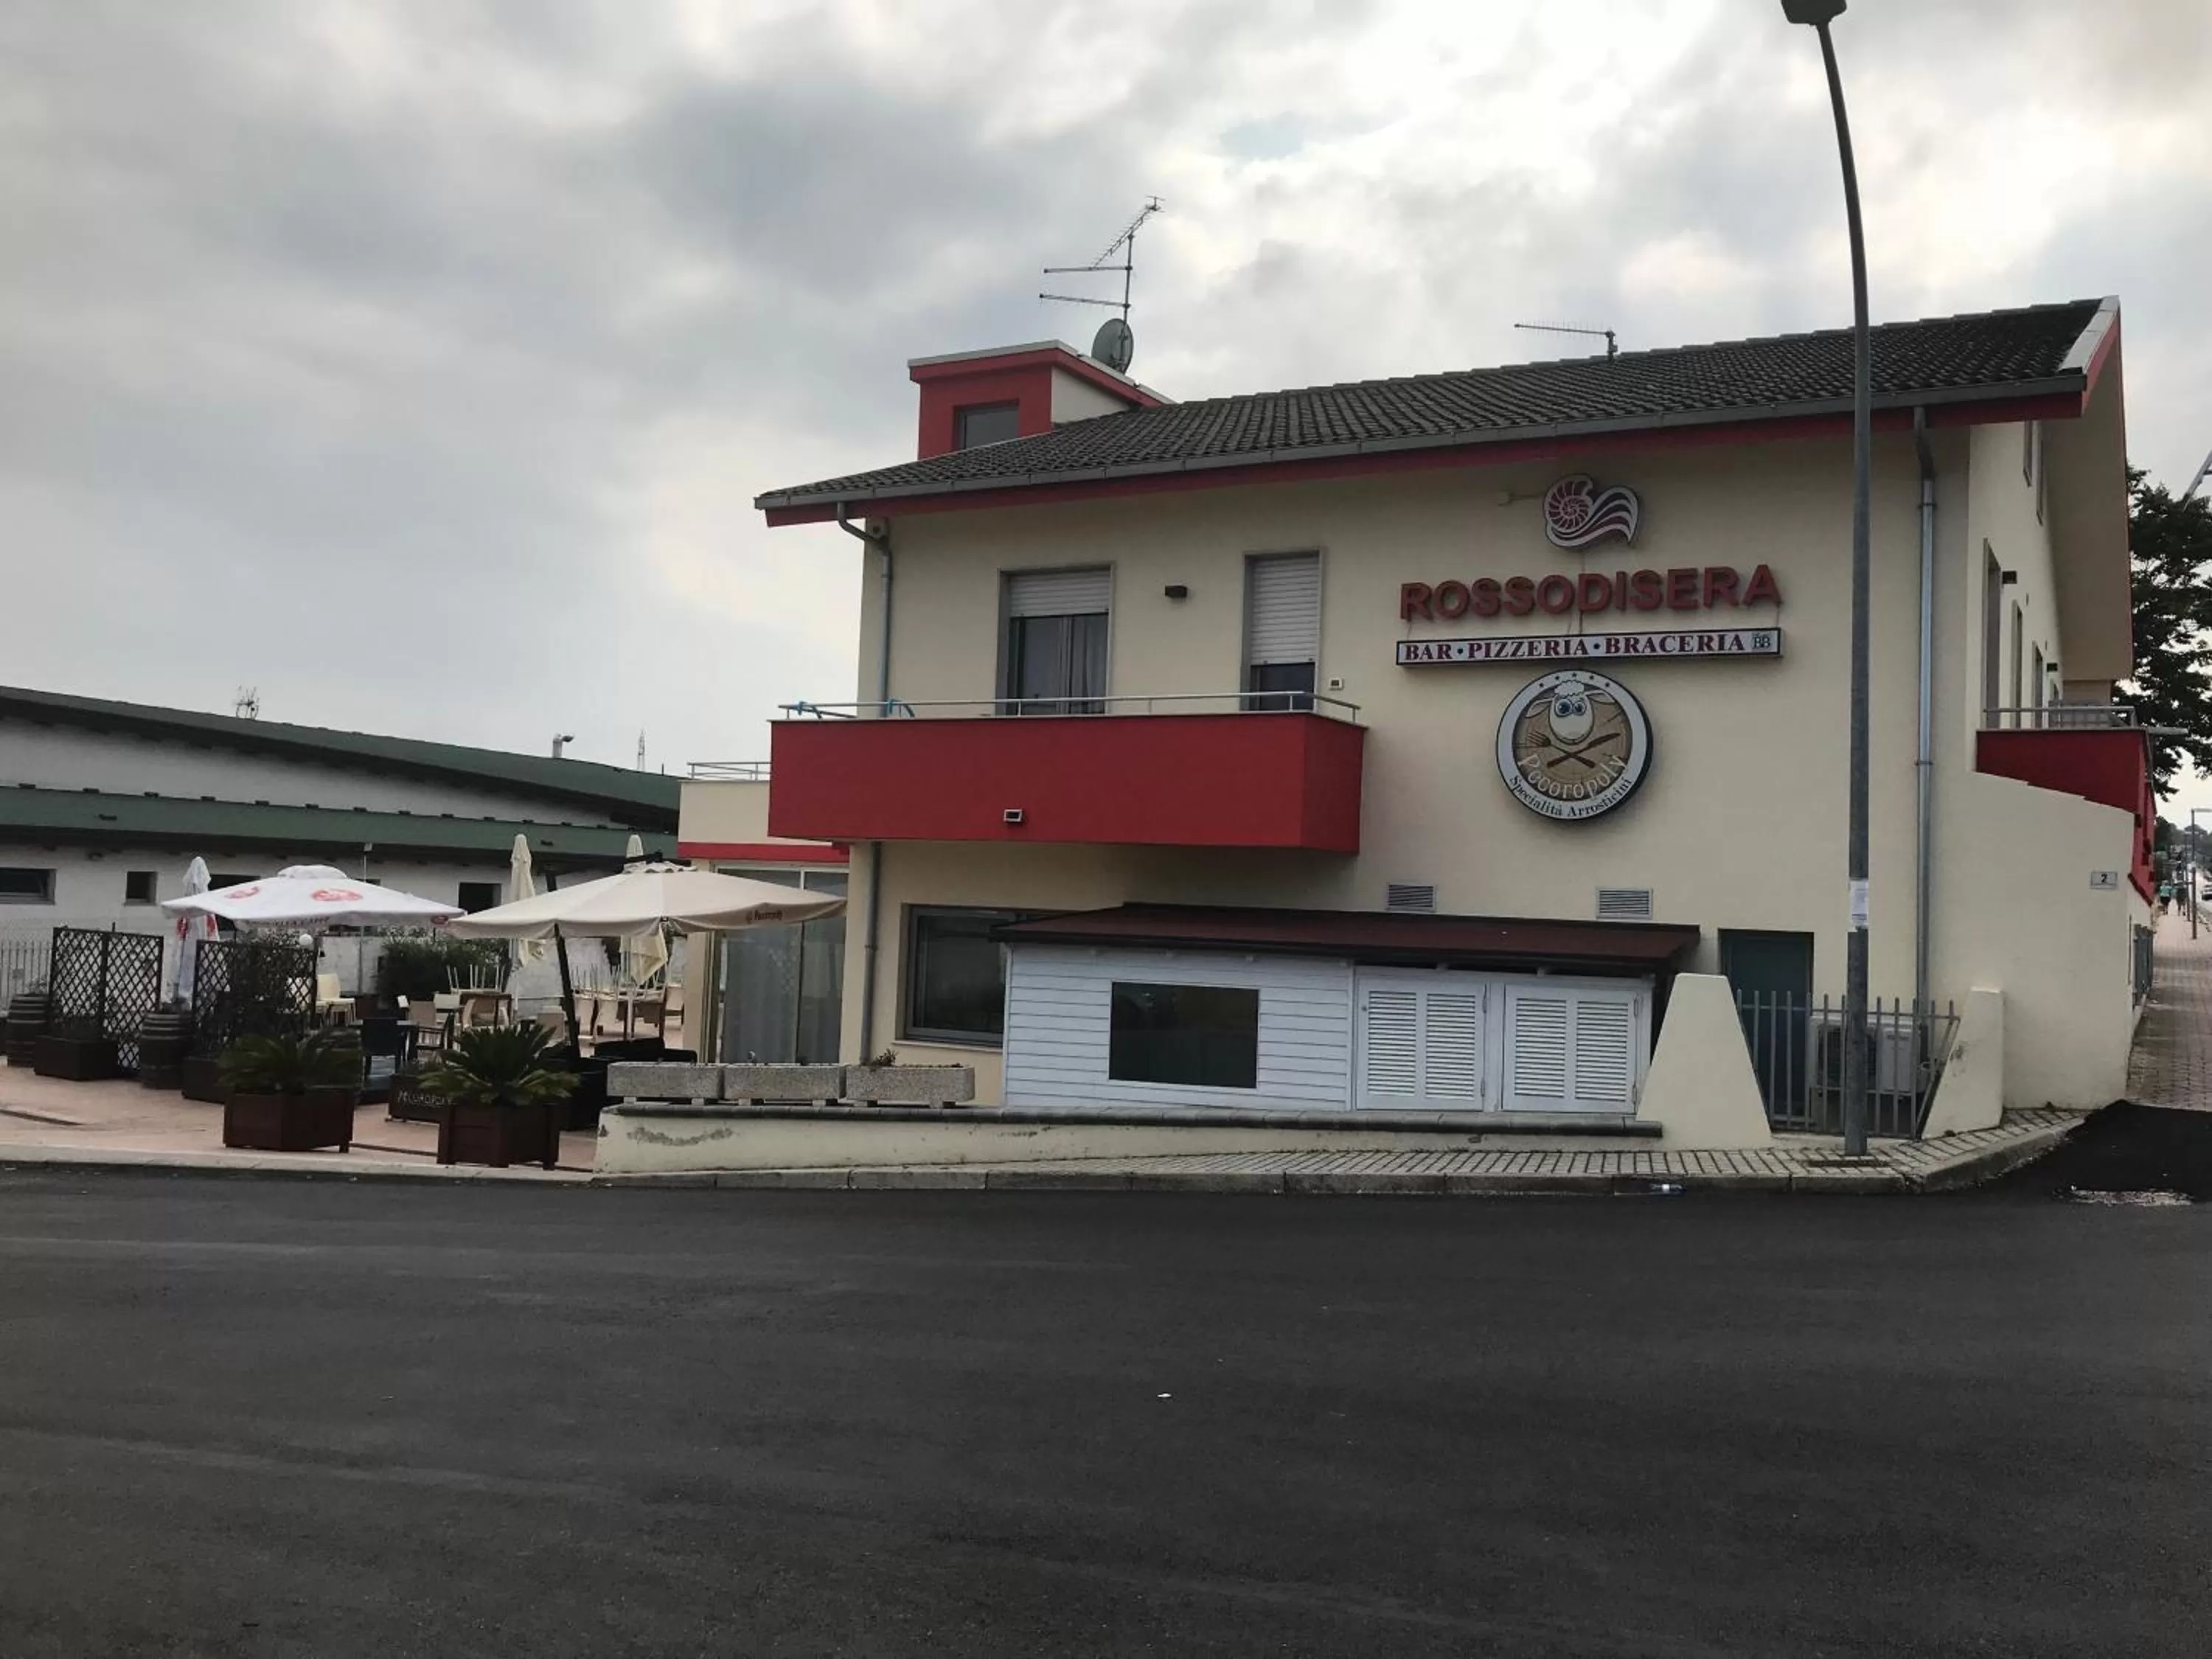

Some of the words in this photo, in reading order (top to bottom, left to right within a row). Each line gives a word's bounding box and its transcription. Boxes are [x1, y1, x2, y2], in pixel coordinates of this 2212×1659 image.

[1399, 563, 1783, 622] ROSSODISERA
[1405, 644, 1453, 661] BAR
[1467, 639, 1589, 659] PIZZERIA
[1604, 633, 1746, 654] BRACERIA
[1517, 753, 1627, 799] Pecoropoly
[1567, 778, 1632, 818] Arrosticini
